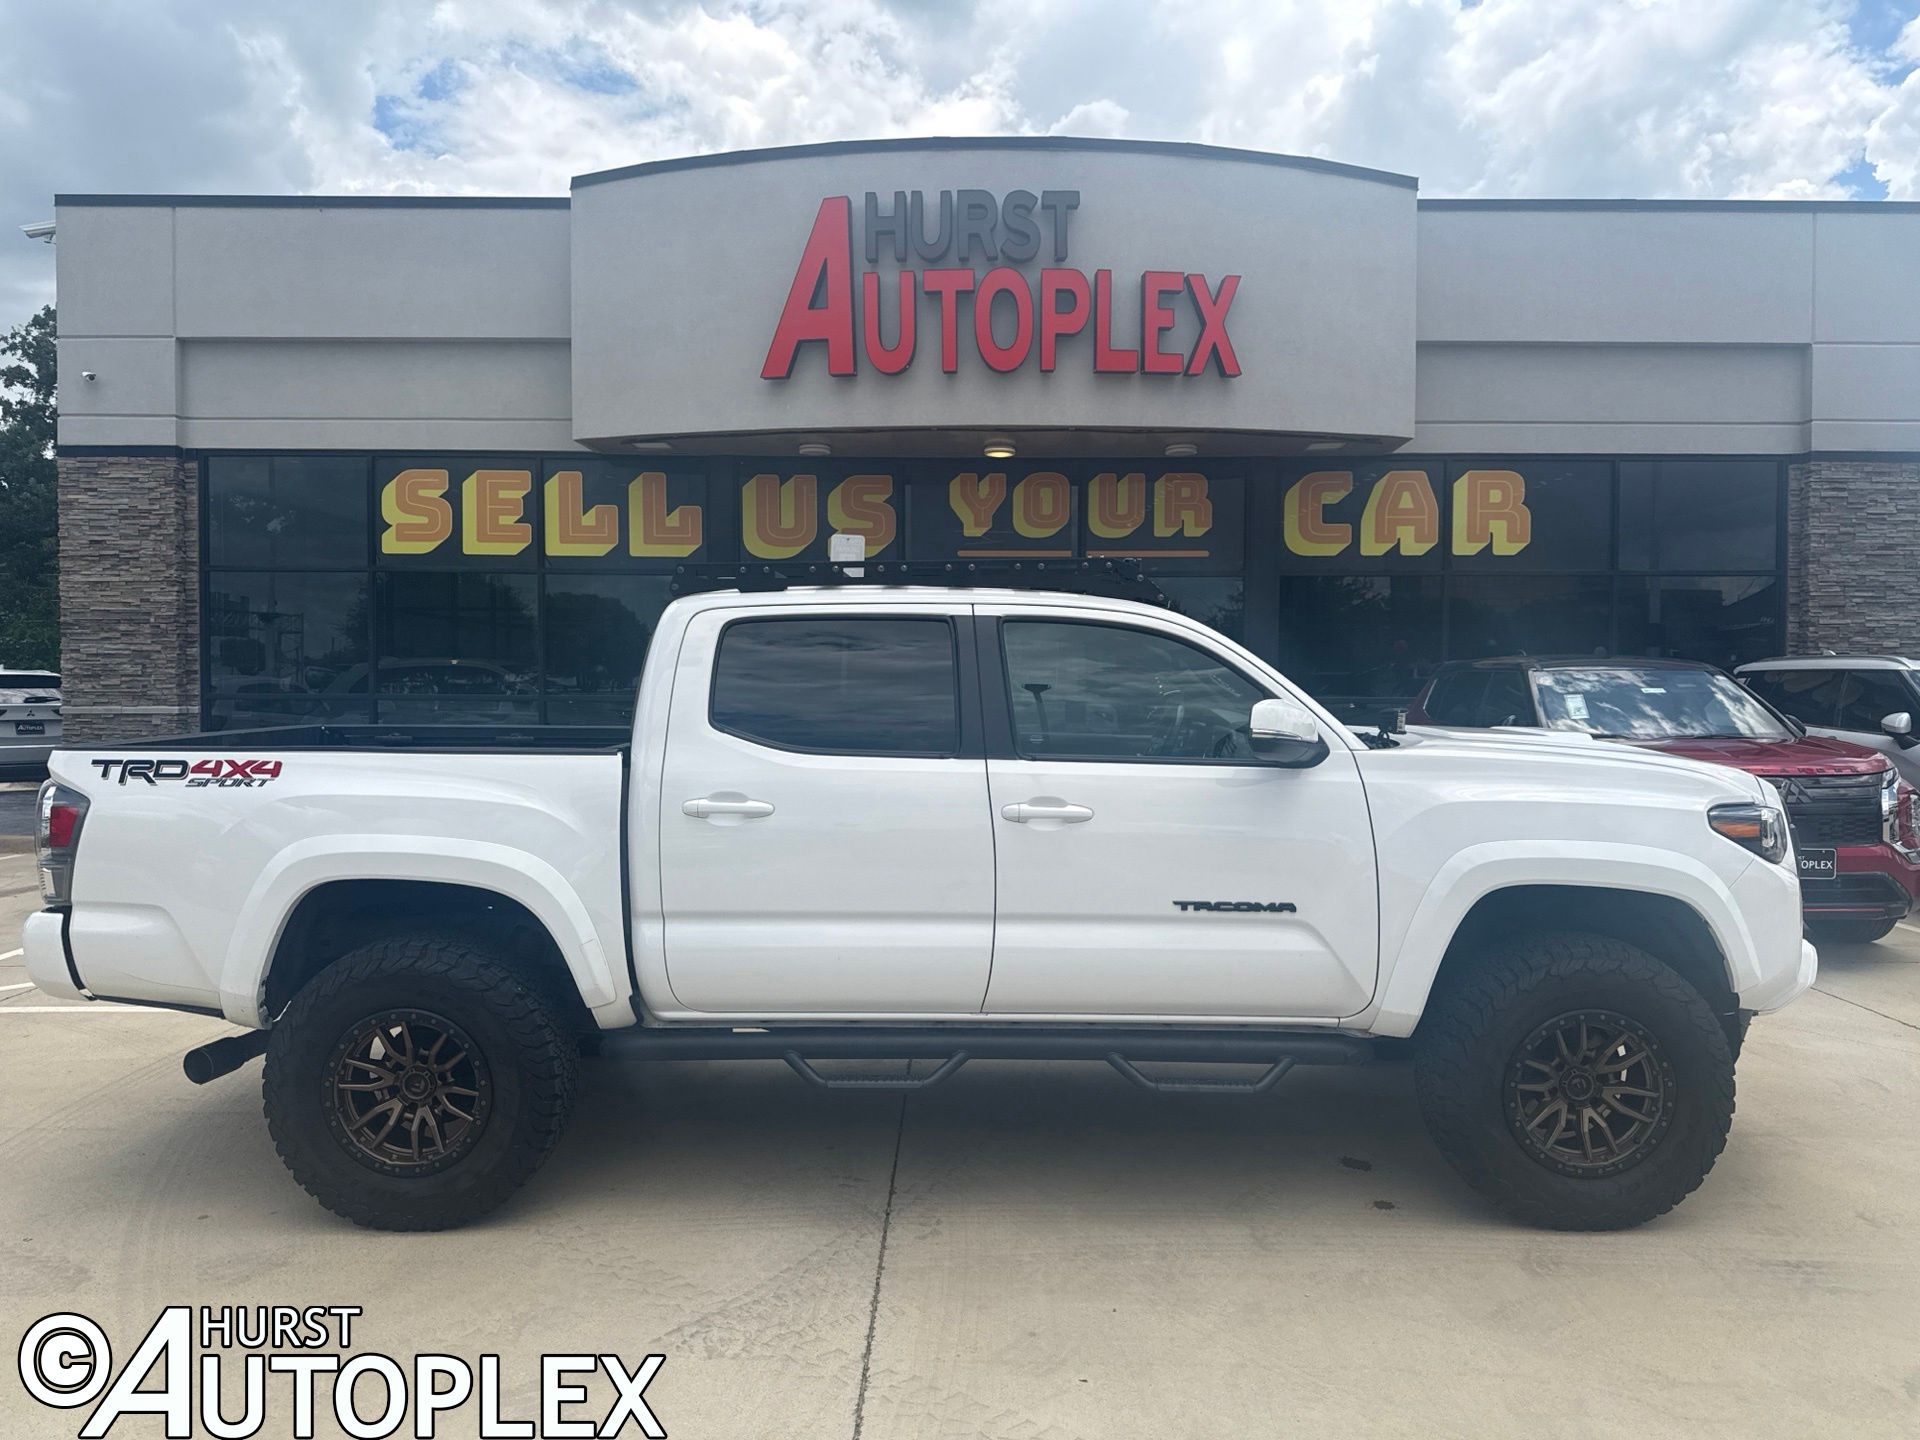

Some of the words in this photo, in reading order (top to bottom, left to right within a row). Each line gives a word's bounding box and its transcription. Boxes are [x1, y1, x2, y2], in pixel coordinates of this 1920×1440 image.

[864, 188, 1081, 262] HURST
[760, 194, 1243, 380] AUTOPLEX
[380, 468, 703, 558] SELL
[741, 473, 898, 560] US
[948, 471, 1214, 539] YOUR
[1283, 470, 1532, 557] CAR
[91, 759, 191, 787] TRD
[184, 777, 276, 788] SPORT
[1801, 860, 1834, 870] OPLEX
[1172, 900, 1297, 913] TACOMA
